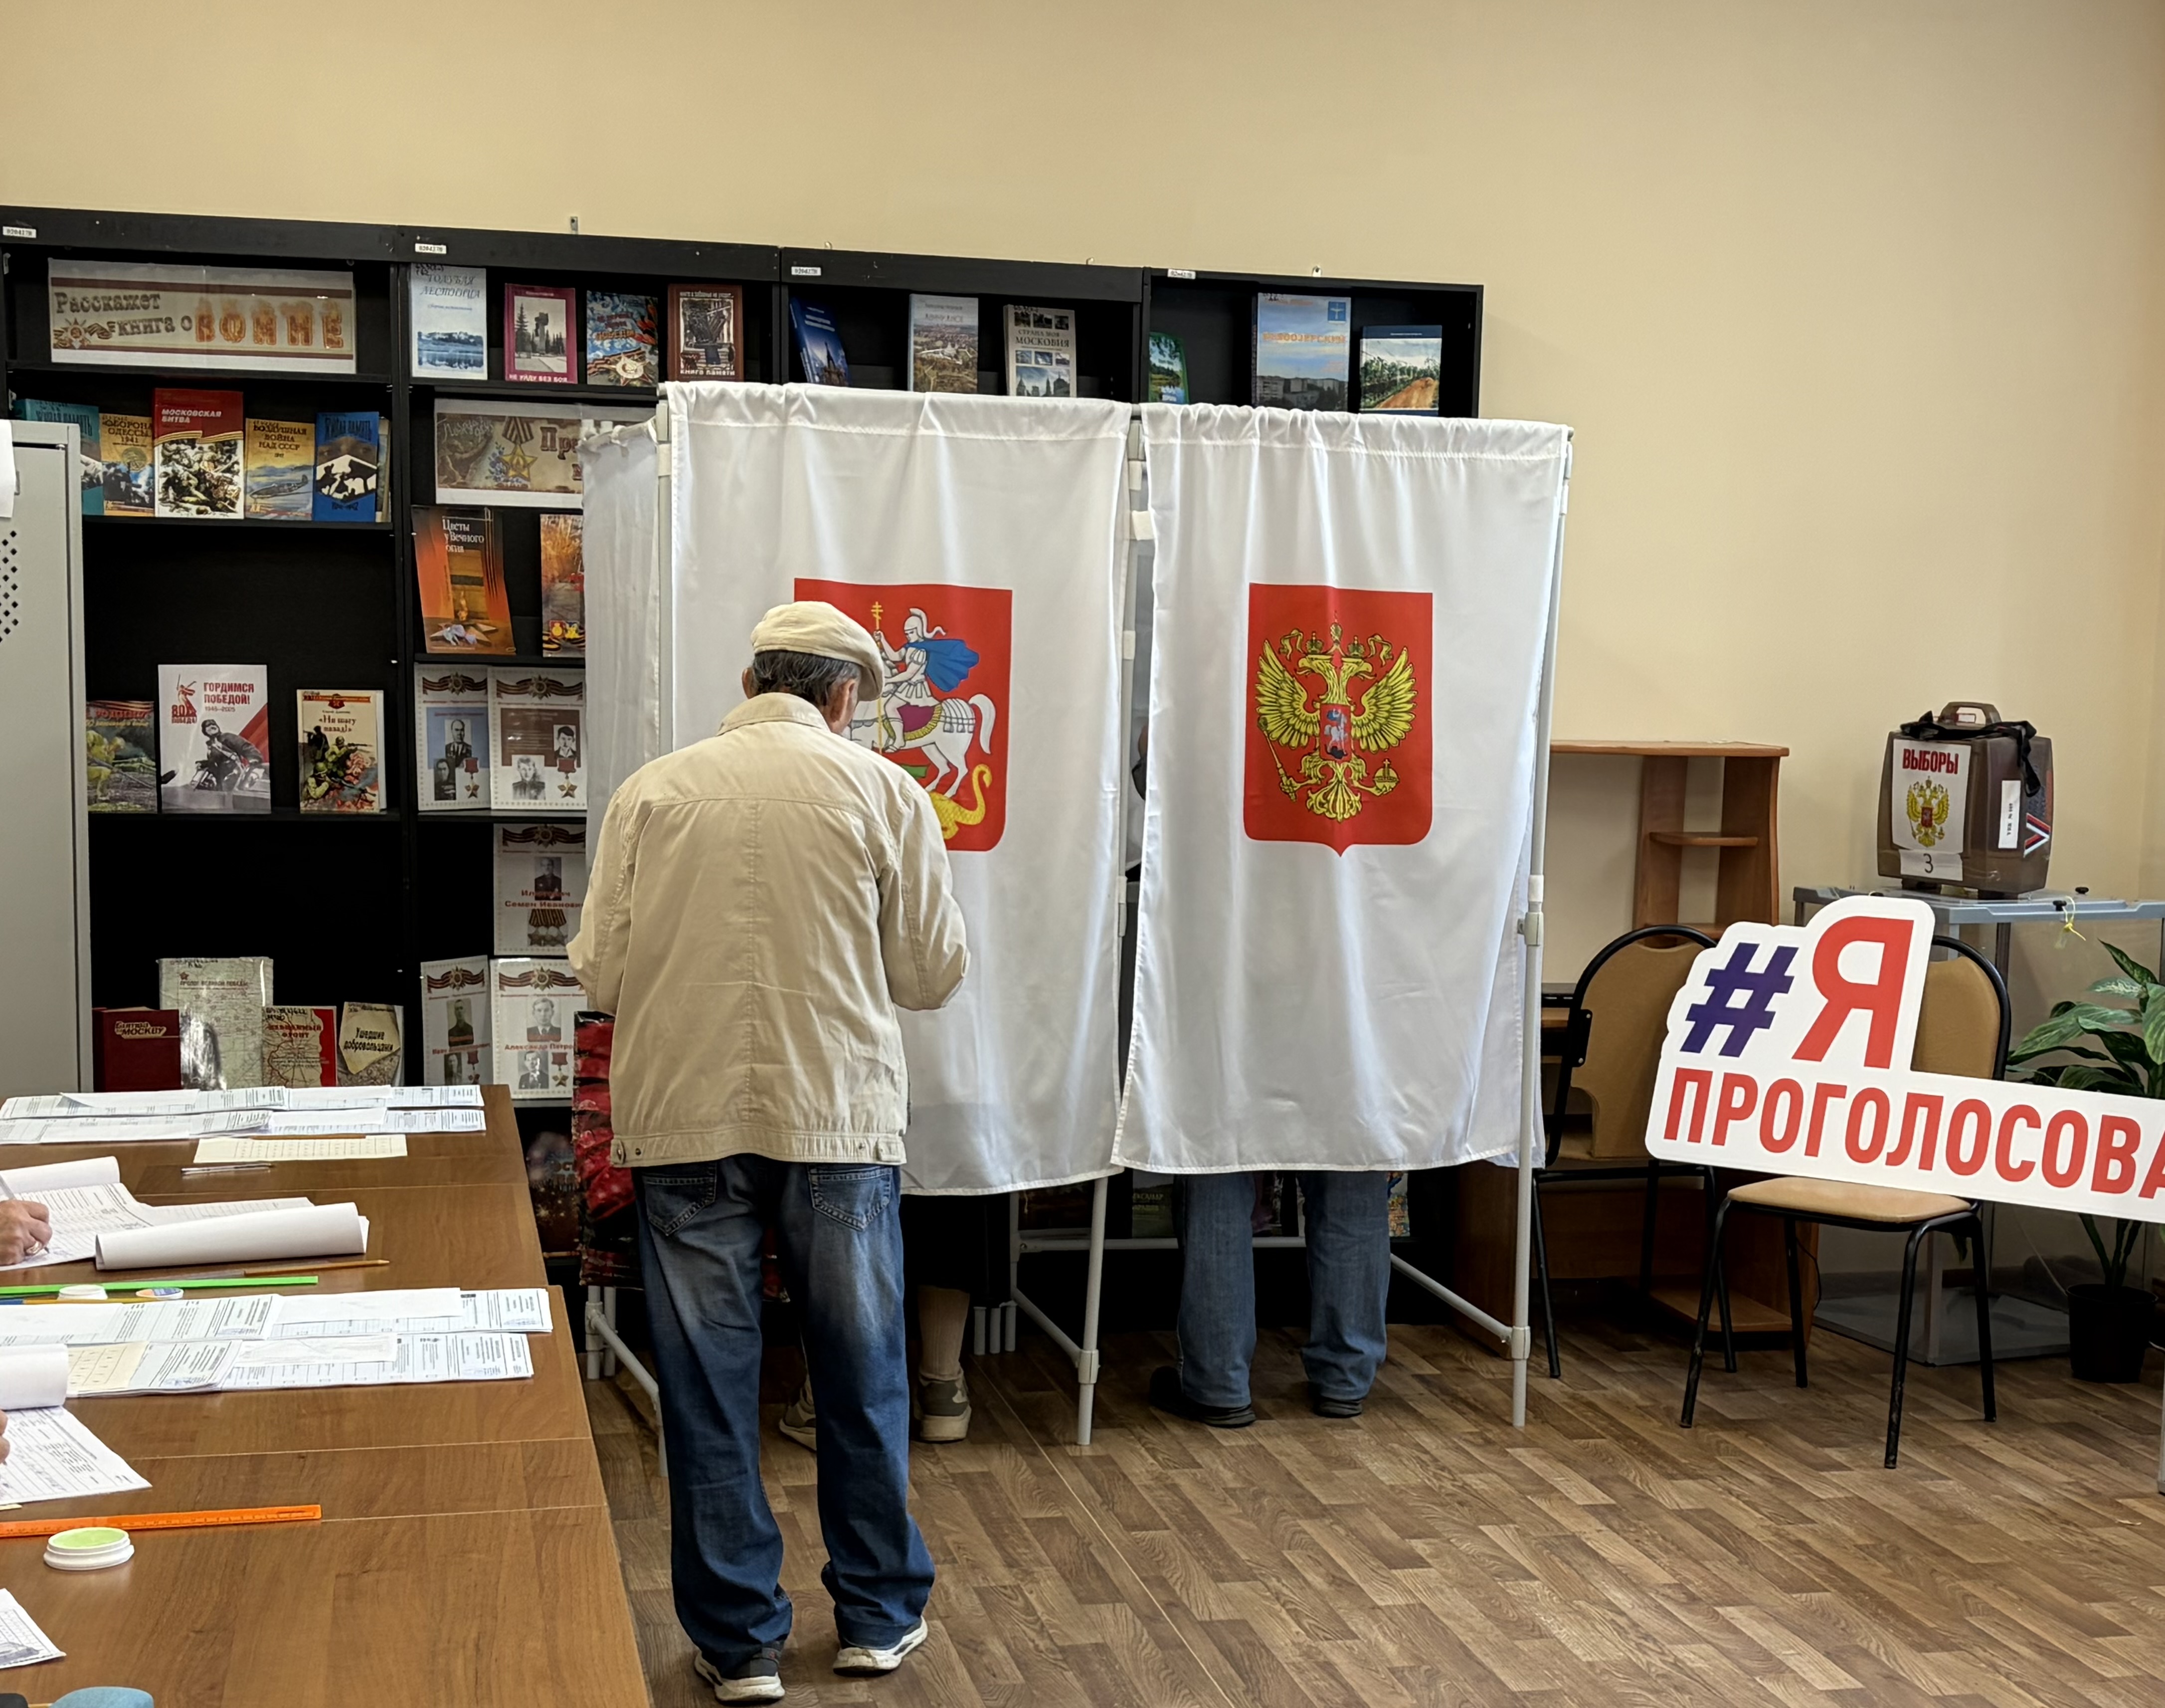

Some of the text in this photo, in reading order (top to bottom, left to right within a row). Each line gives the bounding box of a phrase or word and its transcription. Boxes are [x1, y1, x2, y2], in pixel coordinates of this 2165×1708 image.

[54, 291, 161, 314] Расскажет
[116, 316, 176, 336] книга
[181, 315, 193, 332] о
[1016, 336, 1070, 348] МОСКОВИЯ
[162, 409, 222, 417] МОСКОВСКАЯ
[264, 434, 295, 442] ВОЙНА
[442, 519, 470, 532] Цветы
[450, 532, 485, 543] Вечного
[203, 682, 254, 693] ГОРДИМСЯ
[204, 694, 250, 705] ПОБЕДОЙ!
[1902, 749, 1959, 774] ВЫБОРЫ
[1923, 853, 1933, 873] 3
[122, 1027, 164, 1036] МОСКВУ
